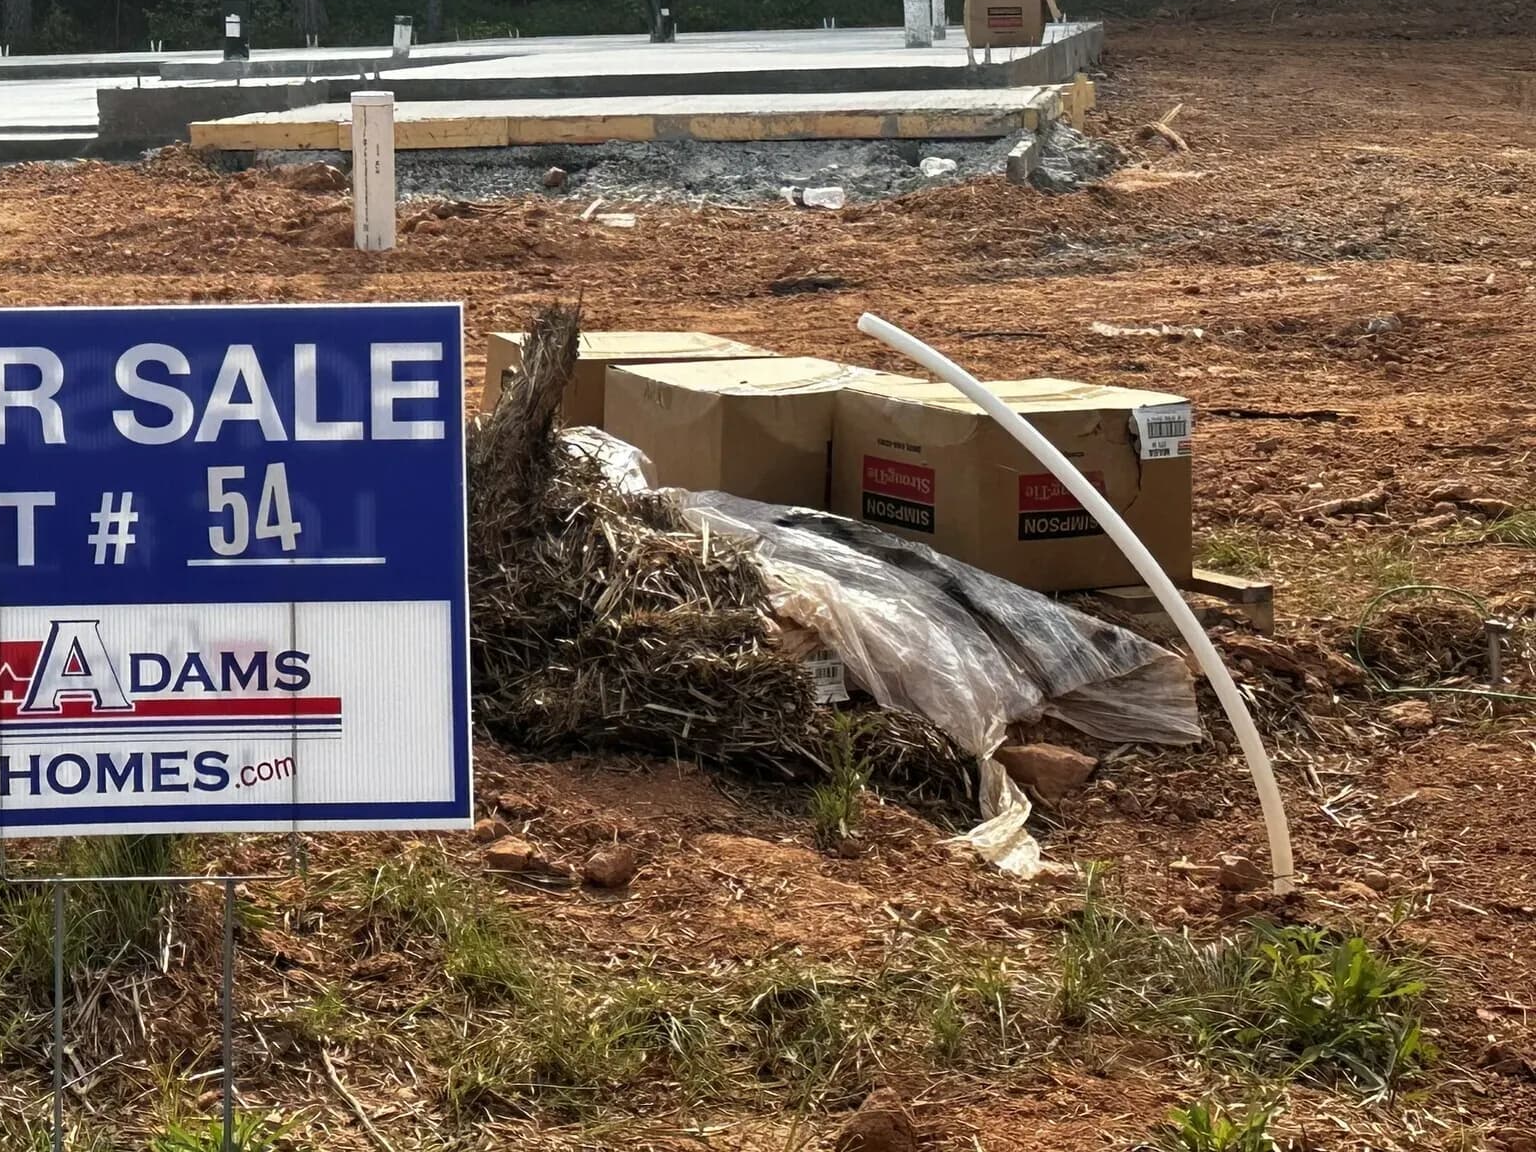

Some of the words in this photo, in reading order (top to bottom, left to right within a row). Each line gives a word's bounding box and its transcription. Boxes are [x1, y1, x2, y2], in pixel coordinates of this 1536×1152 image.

[112, 342, 446, 445] SALE
[87, 492, 139, 566] #
[206, 462, 303, 557] 54
[866, 498, 930, 527] SIMPSON
[19, 619, 311, 713] ADAMS
